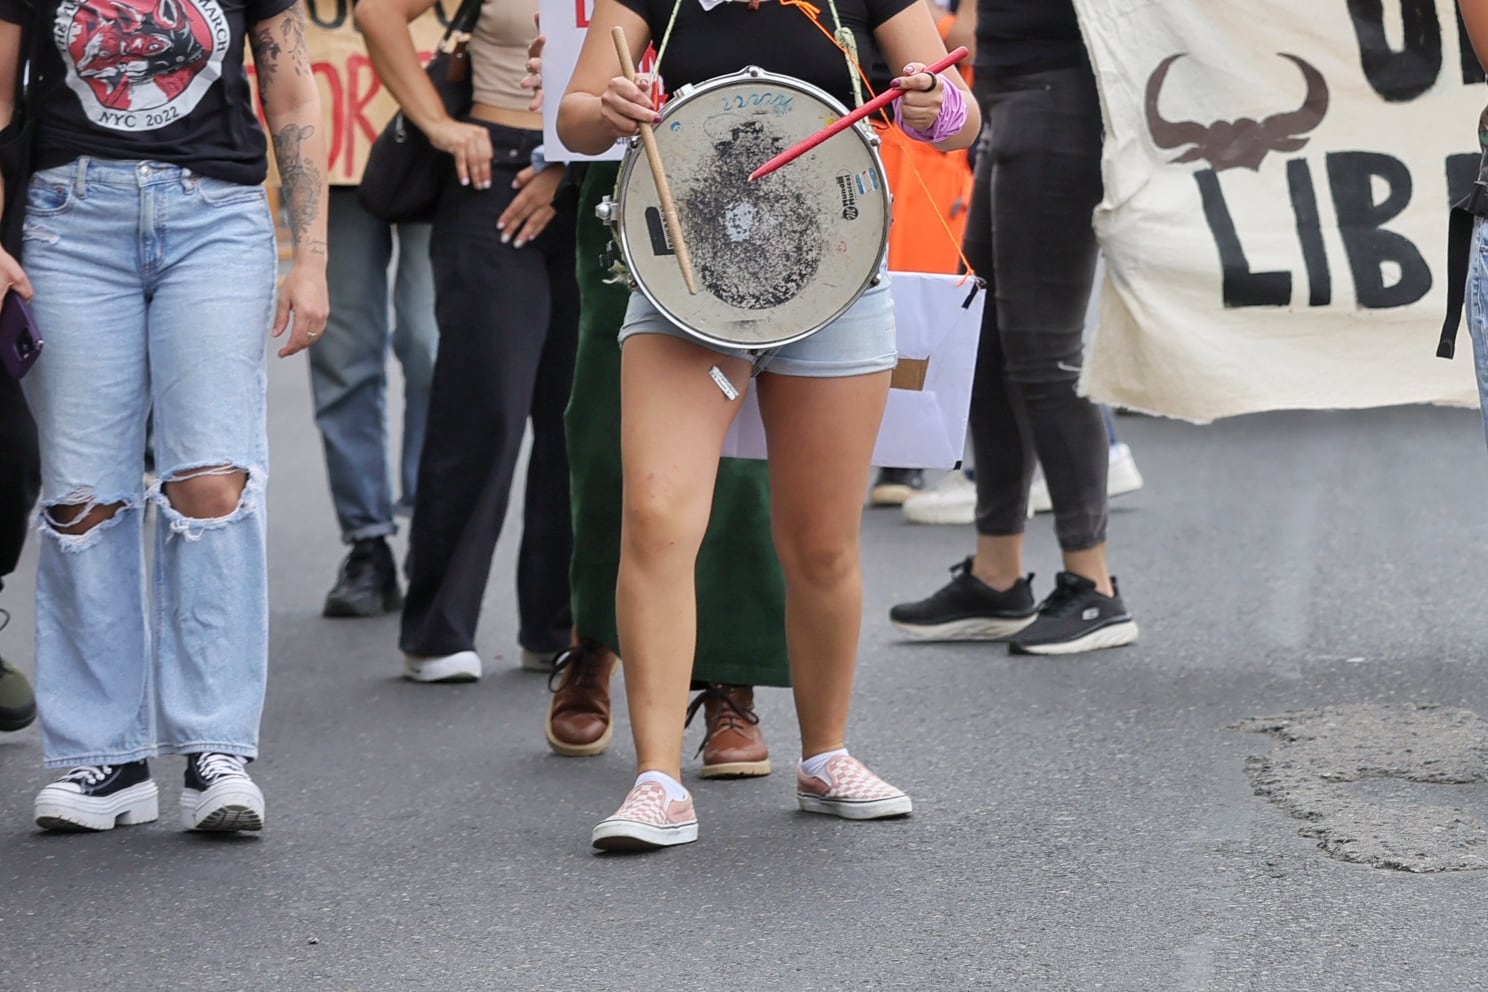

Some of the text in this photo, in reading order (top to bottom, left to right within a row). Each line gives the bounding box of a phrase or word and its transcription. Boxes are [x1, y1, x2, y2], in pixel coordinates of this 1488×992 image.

[98, 106, 180, 128] NYC 2022
[845, 174, 856, 206] Musical
